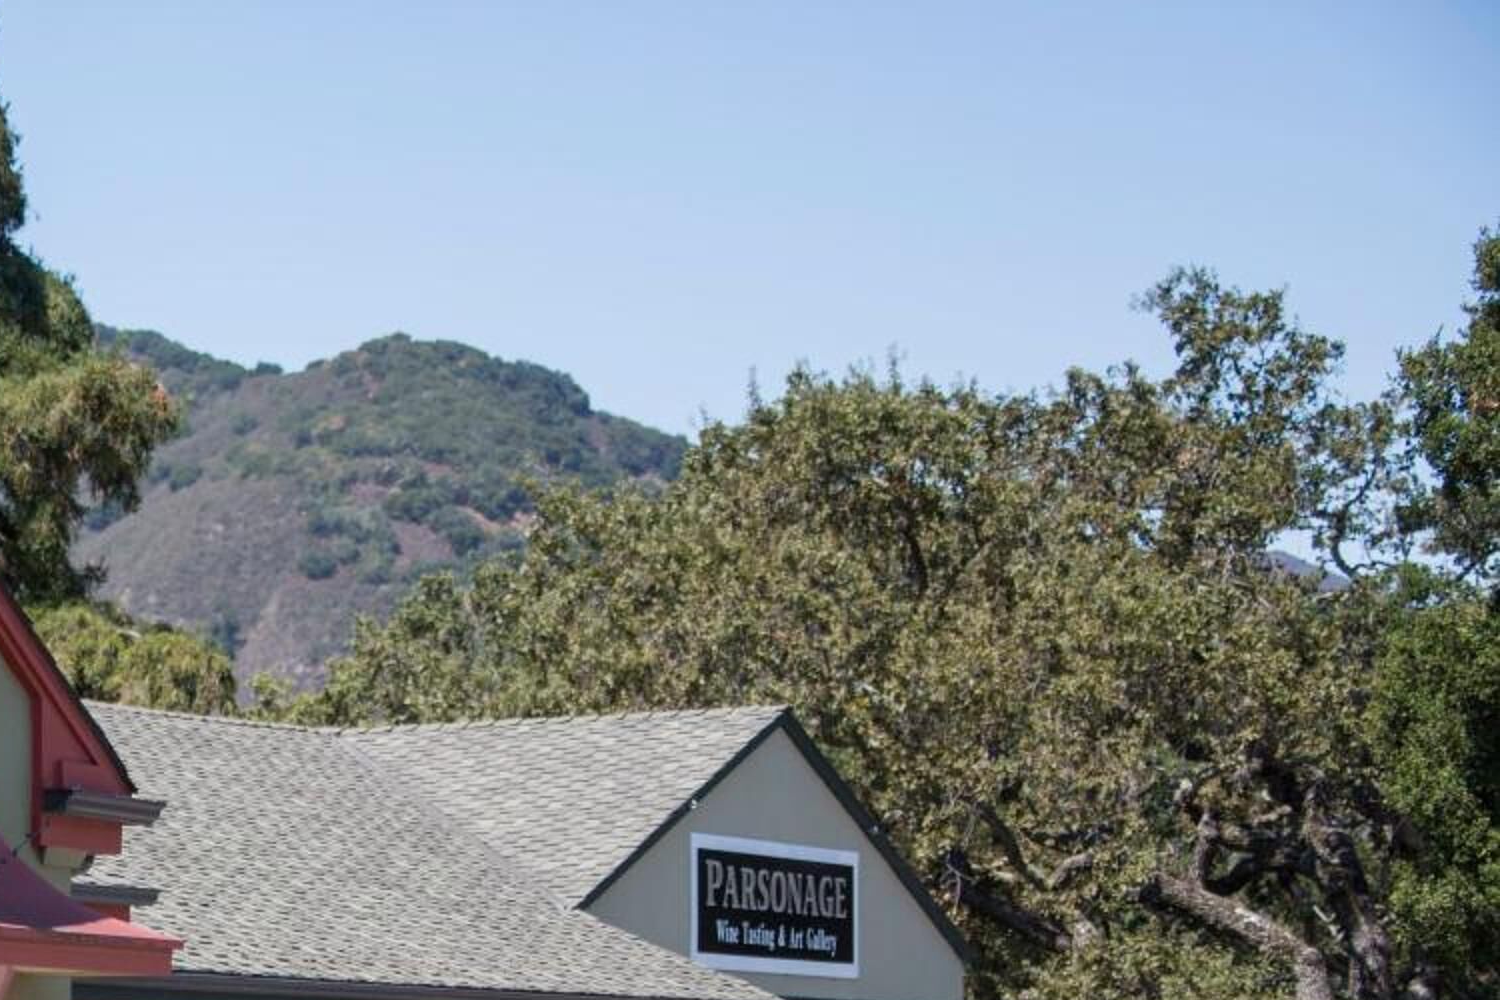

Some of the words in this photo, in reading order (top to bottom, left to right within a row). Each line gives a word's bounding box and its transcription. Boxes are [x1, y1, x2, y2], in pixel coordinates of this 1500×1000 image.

[705, 859, 848, 920] PARSONAGE
[717, 920, 738, 943] Wine
[743, 921, 775, 951] Tasting
[778, 925, 786, 947] &
[789, 929, 805, 949] Art
[806, 930, 837, 956] Gallery
